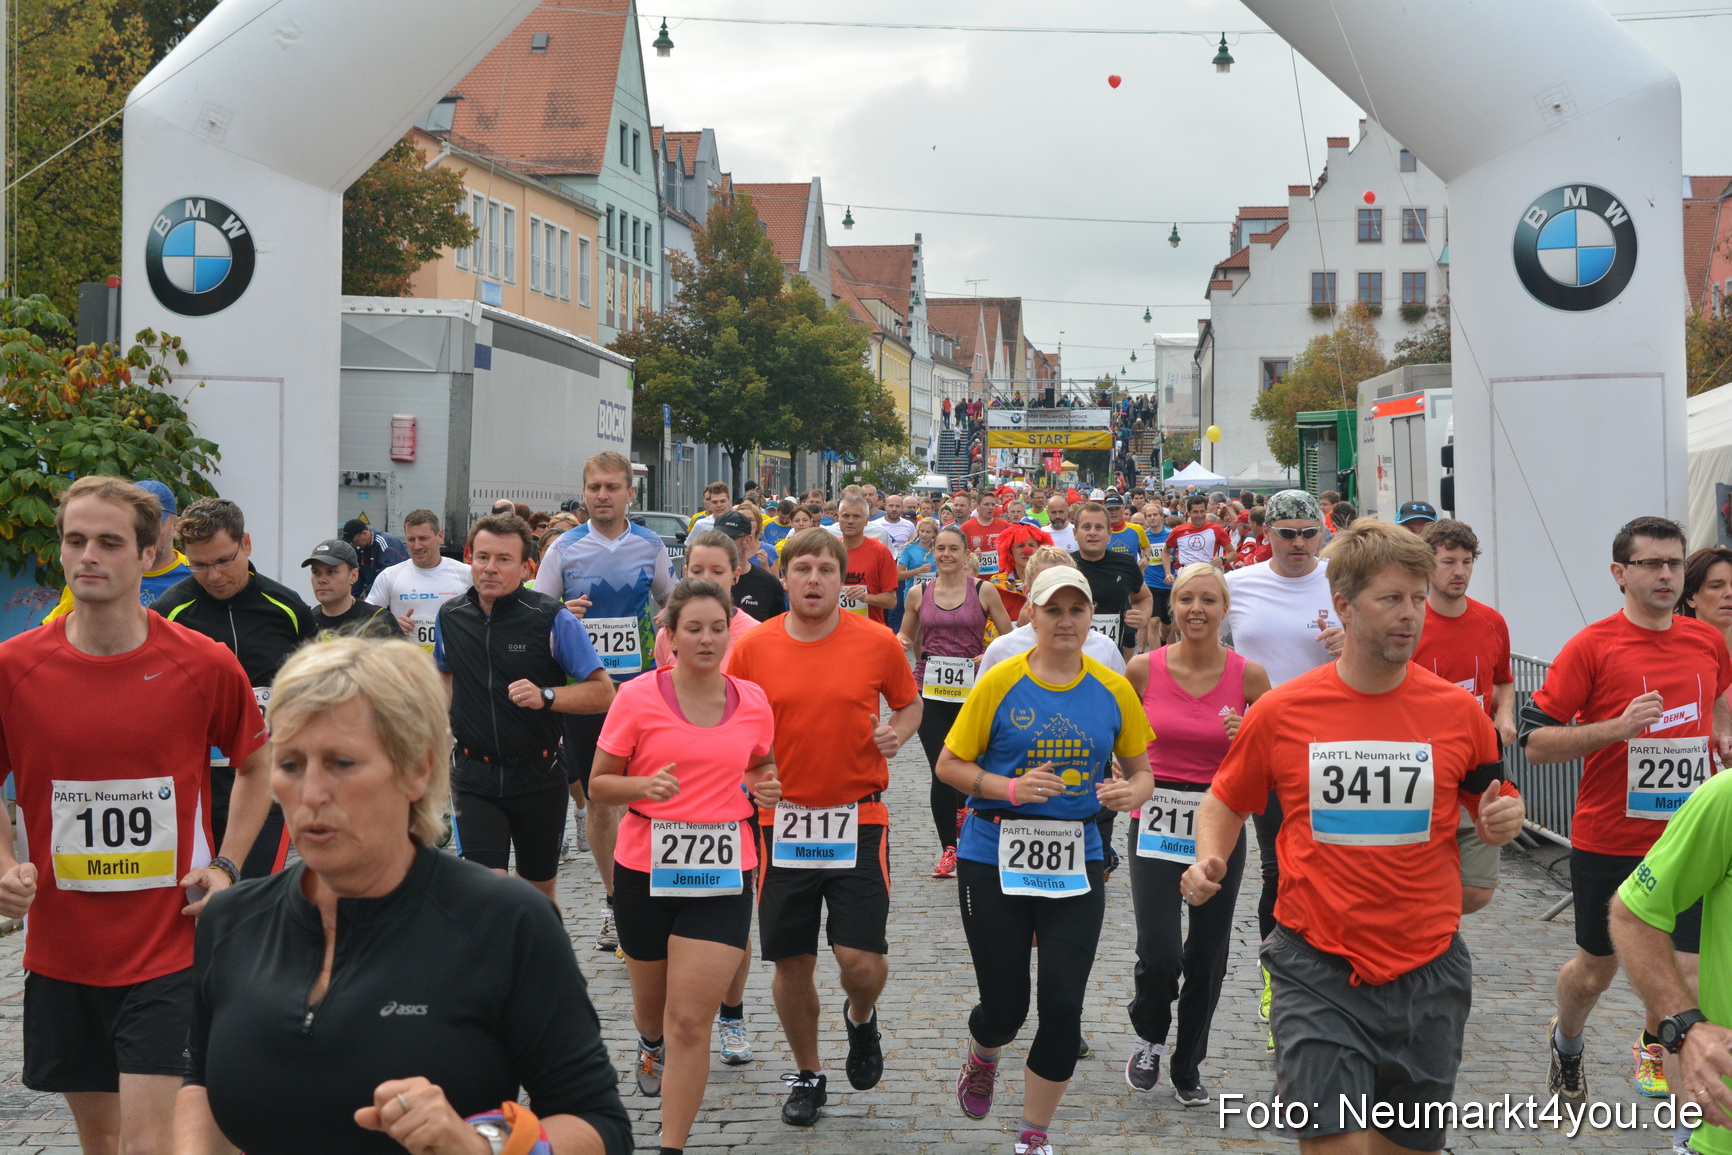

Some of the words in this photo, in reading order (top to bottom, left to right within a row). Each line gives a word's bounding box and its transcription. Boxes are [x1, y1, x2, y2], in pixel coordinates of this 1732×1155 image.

[1522, 187, 1629, 231] BMW
[152, 199, 248, 240] BMW
[596, 398, 627, 443] BOCK
[1028, 434, 1071, 445] START
[602, 622, 631, 630] Neumarkt
[588, 631, 636, 653] 2125
[604, 658, 620, 667] Sigi
[934, 667, 965, 685] 194
[934, 687, 962, 697] Rebecca
[1663, 711, 1686, 724] DEHN
[1312, 750, 1352, 760] PARTL
[1354, 751, 1411, 761] Neumarkt
[1630, 746, 1661, 755] PARTL
[1663, 745, 1701, 755] Neumarkt
[1637, 757, 1706, 789] 2294
[1322, 765, 1422, 804] 3417
[54, 791, 92, 802] PARTL
[95, 790, 154, 801] Neumarkt
[1149, 795, 1169, 804] ARTL
[1170, 797, 1201, 807] Neumar
[76, 806, 152, 848] 109
[653, 822, 684, 830] PARTL
[686, 821, 726, 830] Neumarkt
[782, 811, 850, 839] 2117
[1002, 827, 1032, 836] PARTL
[1033, 828, 1072, 837] Neumarkt
[661, 834, 733, 865] 2726
[795, 846, 835, 858] Markus
[1160, 840, 1196, 854] Andrea
[1008, 839, 1075, 871] 2881
[87, 859, 140, 876] Martin
[672, 873, 721, 886] Jennifer
[1022, 876, 1066, 889] Sabrina
[396, 1004, 429, 1015] asics
